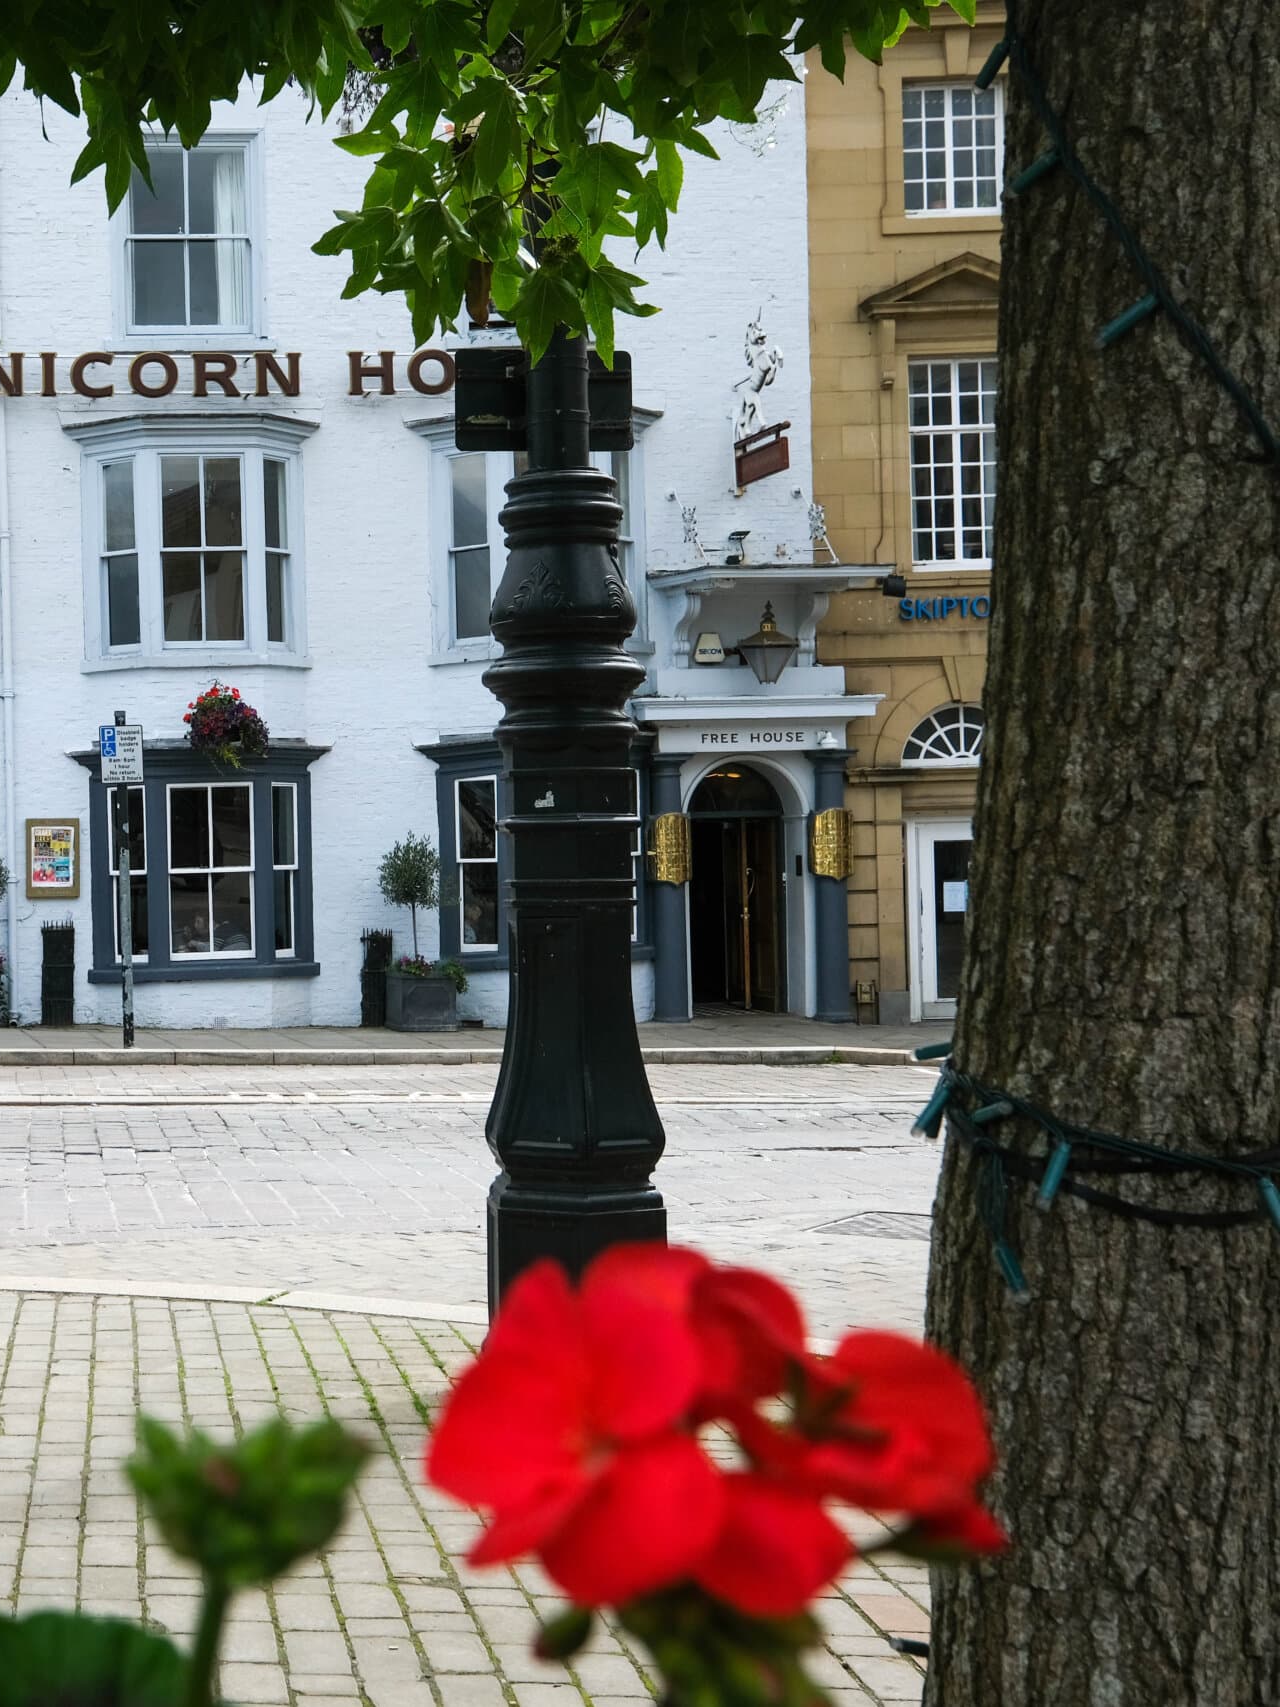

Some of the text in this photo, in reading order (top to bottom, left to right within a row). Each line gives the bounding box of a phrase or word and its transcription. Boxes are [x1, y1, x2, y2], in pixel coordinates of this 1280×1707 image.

[347, 349, 455, 396] HO
[900, 596, 990, 621] SKIPTO
[701, 732, 805, 744] FREE HOUSE
